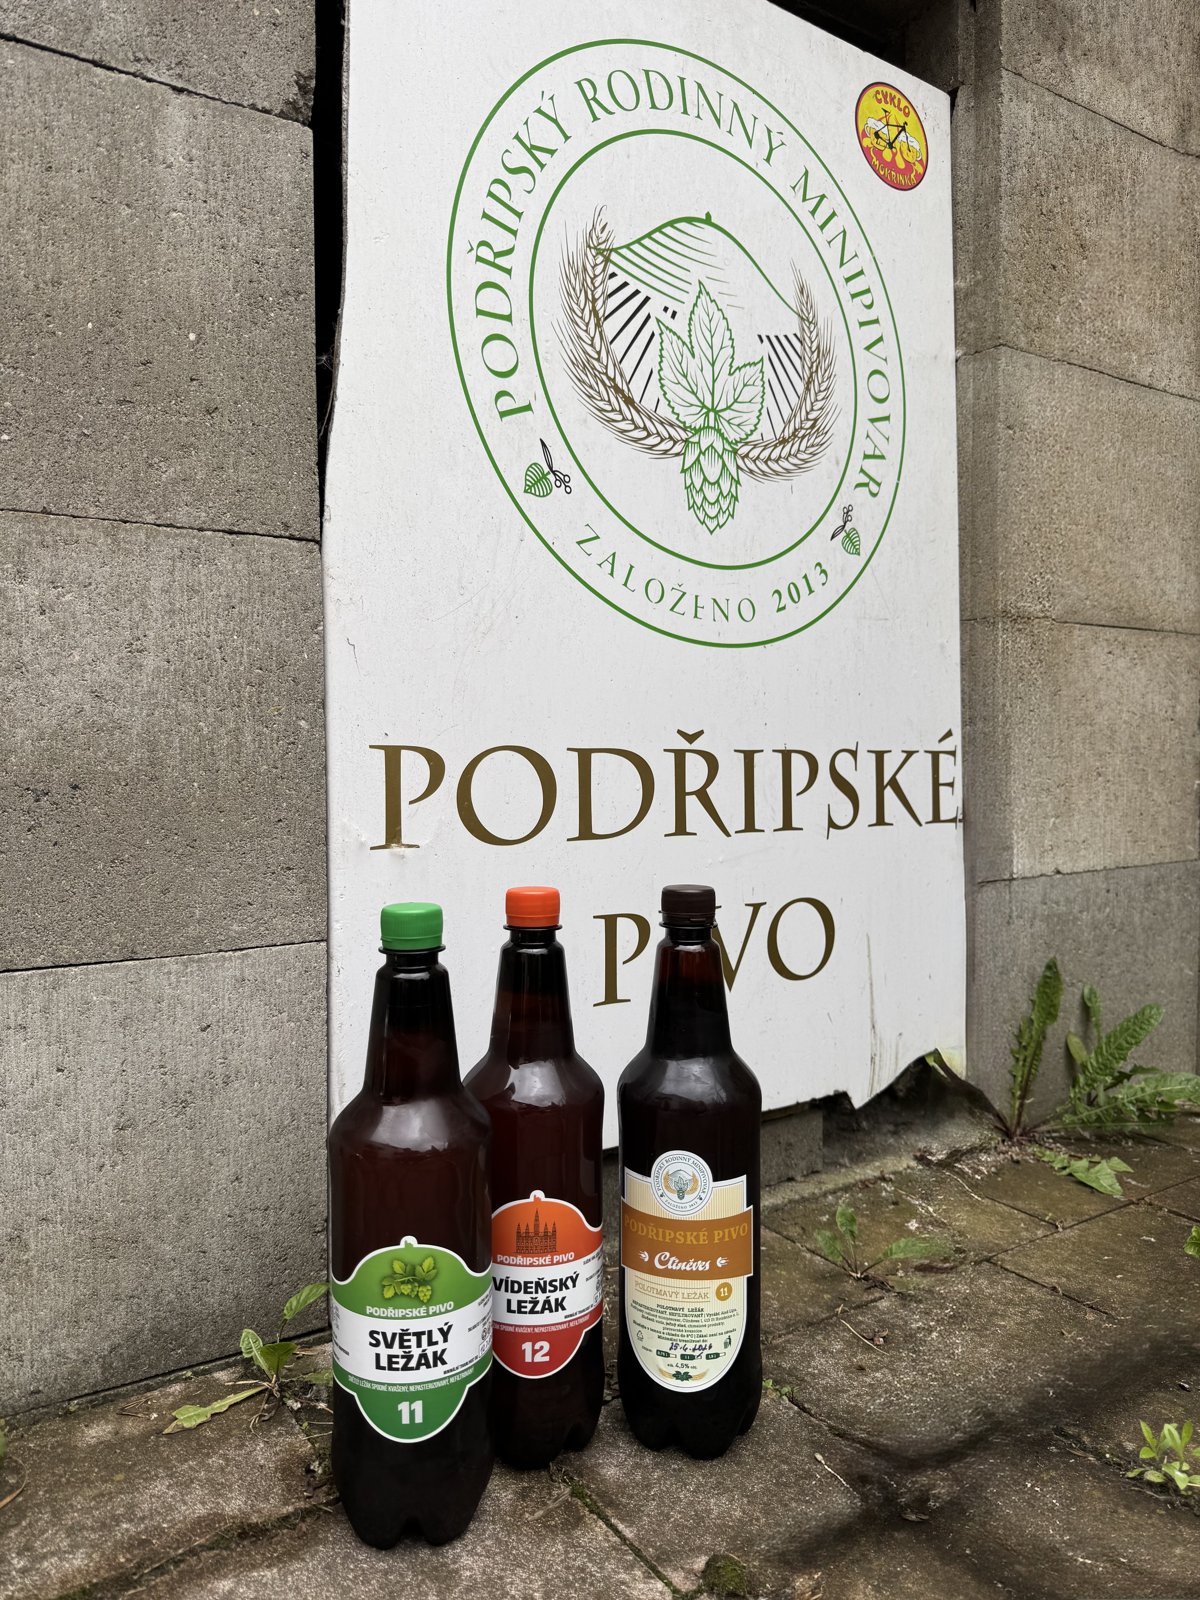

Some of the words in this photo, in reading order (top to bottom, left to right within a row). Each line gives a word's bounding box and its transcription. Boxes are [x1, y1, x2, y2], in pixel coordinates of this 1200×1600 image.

[874, 90, 911, 118] CYKLO
[467, 90, 572, 422] PODŘIPSKÝ
[575, 69, 787, 166] RODINNÝ
[790, 166, 892, 499] MINIPIVOVAR
[576, 524, 756, 622] ZALOŽENO
[772, 562, 828, 613] 2013
[368, 728, 959, 850] PODŘIPSKÉ
[593, 897, 836, 1007] PVO
[624, 1215, 709, 1245] PODŘIPSKÉ
[713, 1223, 748, 1243] PIVO
[497, 1254, 552, 1265] PODŘIPSKÉ
[553, 1252, 575, 1264] PIVO
[492, 1270, 580, 1294] VÍDEŇSKÝ
[366, 1305, 427, 1318] PODŘIPSKÉ
[429, 1301, 454, 1314] PIVO
[506, 1296, 567, 1314] LEŽÁK
[368, 1322, 454, 1351] SVĚTLÝ
[375, 1348, 448, 1372] LEŽÁK
[522, 1341, 550, 1362] 12
[397, 1400, 423, 1424] 11
